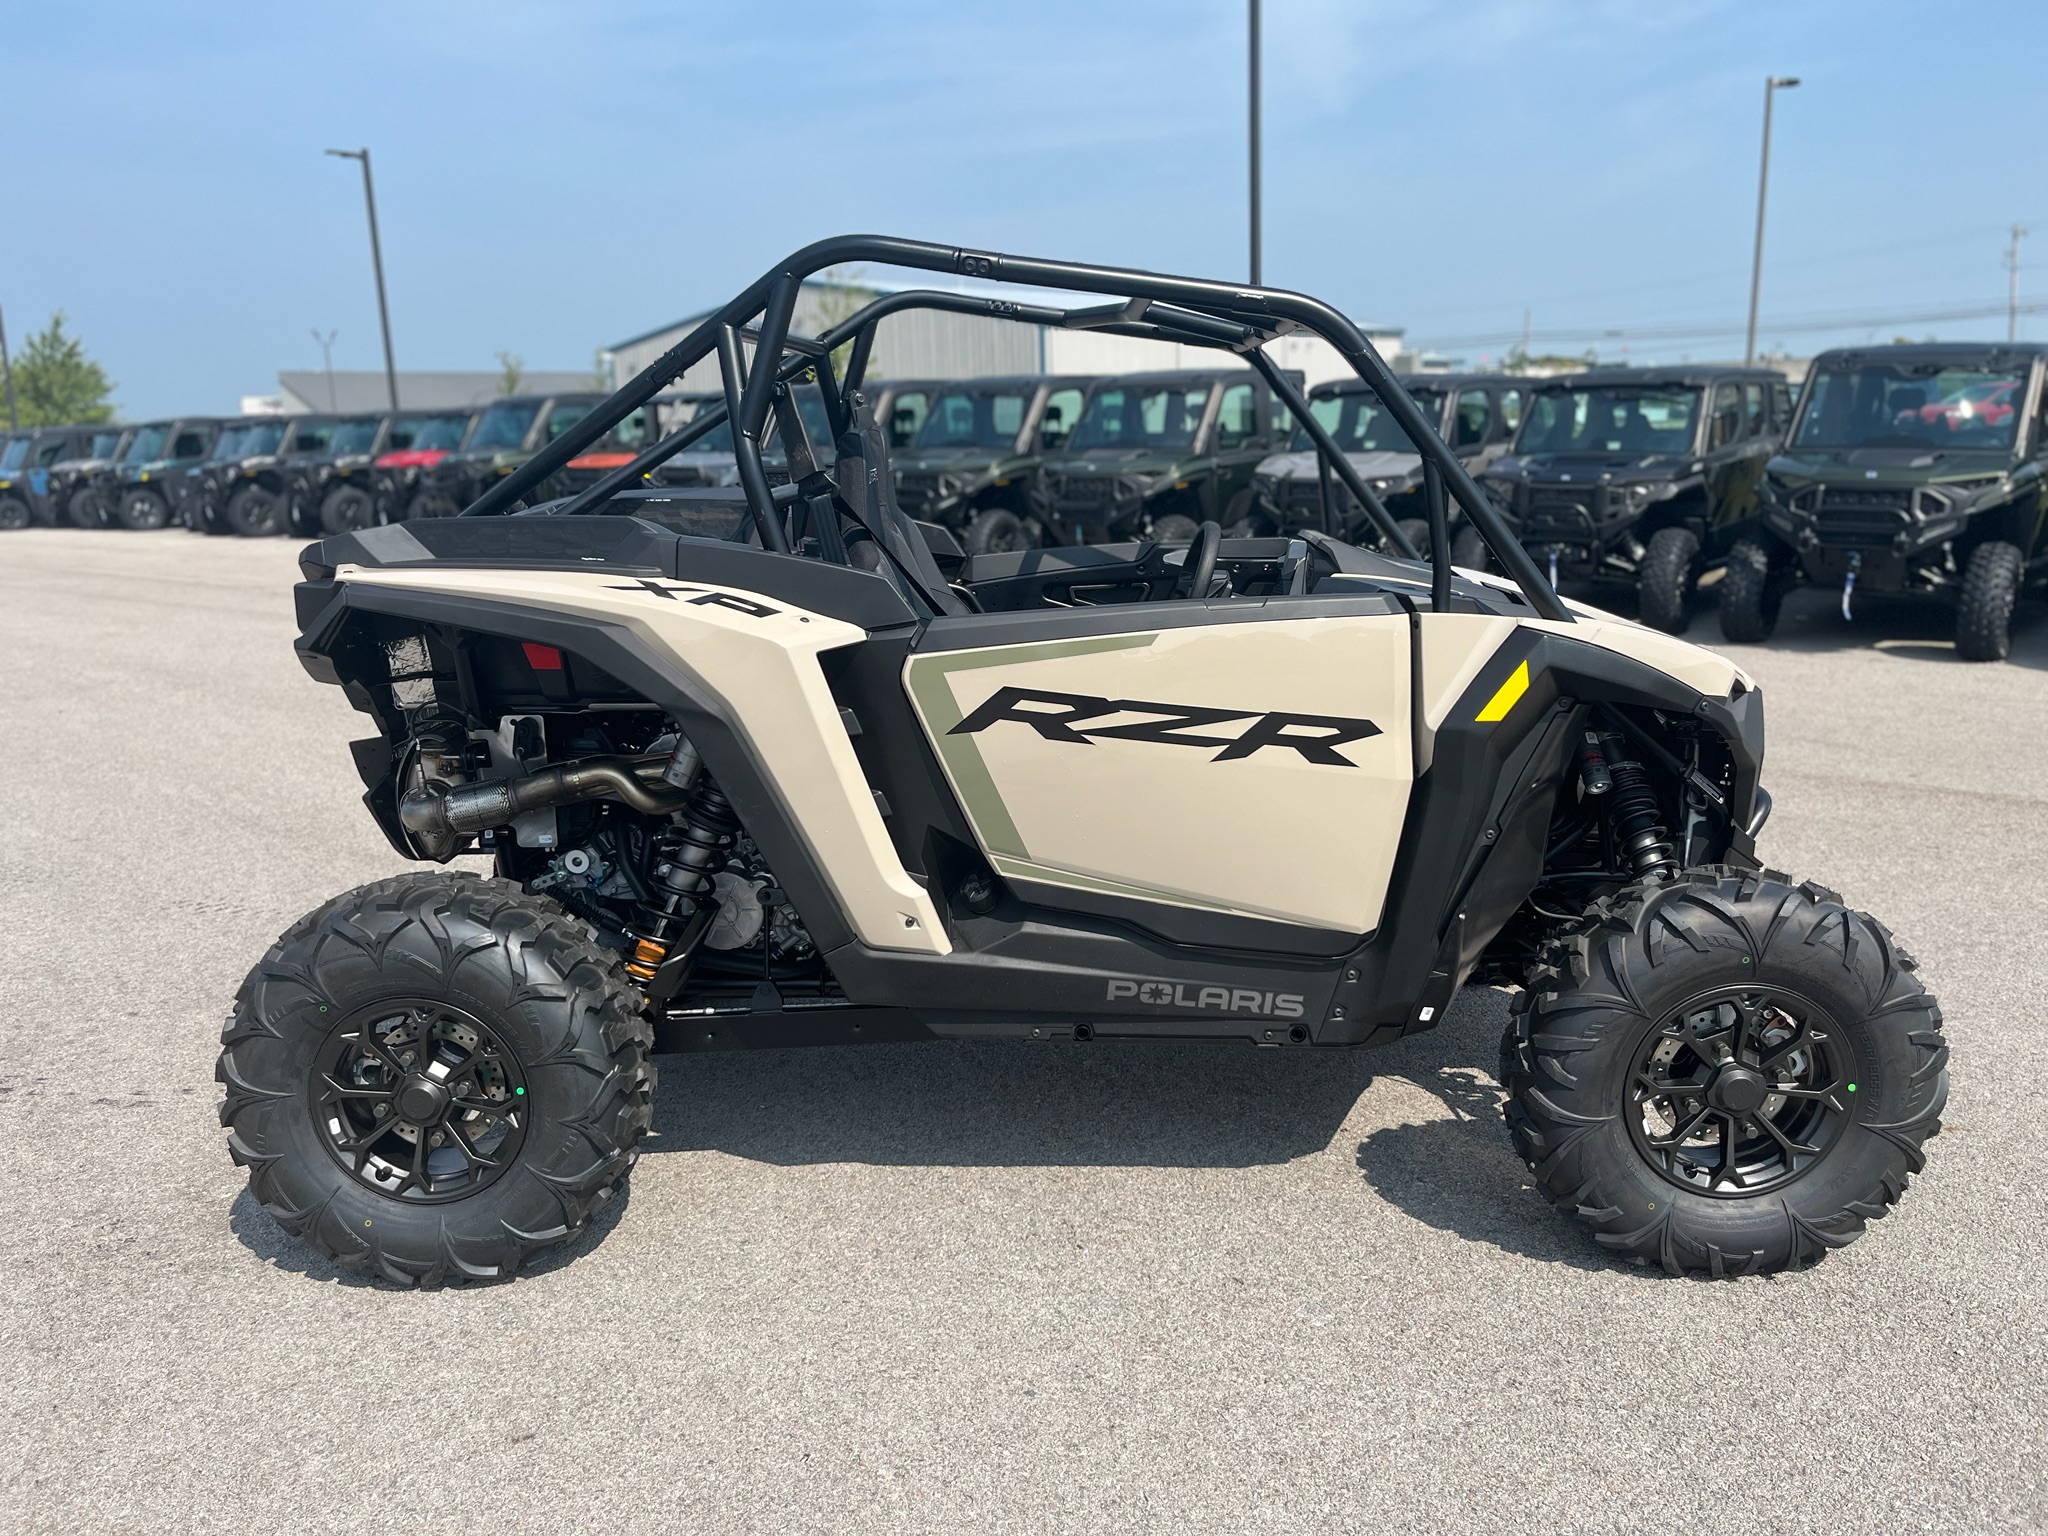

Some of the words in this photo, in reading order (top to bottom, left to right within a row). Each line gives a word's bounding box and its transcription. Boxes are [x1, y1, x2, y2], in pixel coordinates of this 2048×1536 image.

[598, 579, 783, 618] XP
[945, 686, 1384, 767] RZR
[1106, 979, 1304, 1017] POLARIS
